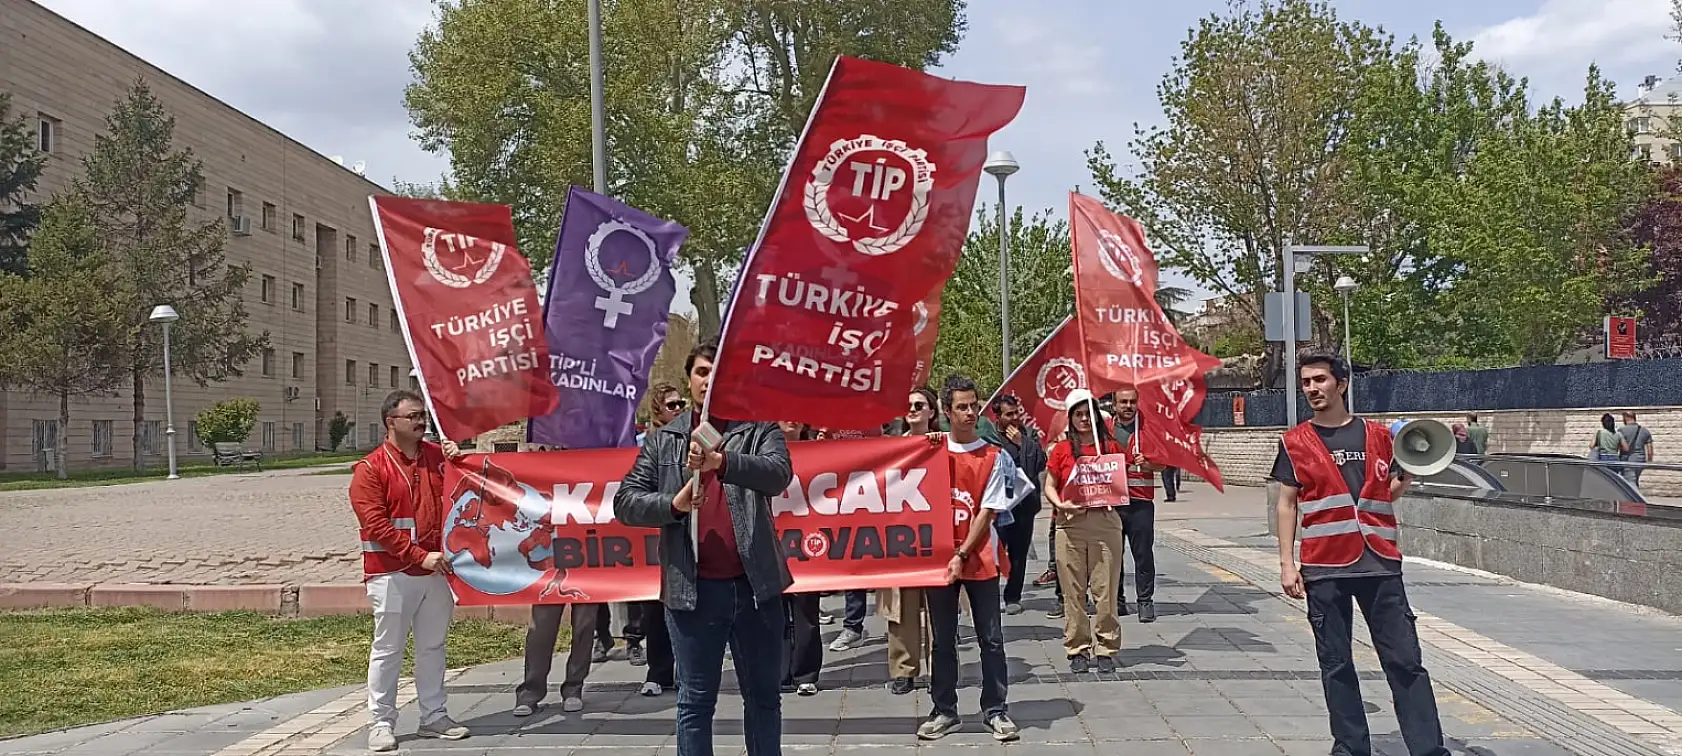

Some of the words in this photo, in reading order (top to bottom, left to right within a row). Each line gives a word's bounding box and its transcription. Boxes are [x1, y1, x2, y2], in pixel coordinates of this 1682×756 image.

[850, 157, 907, 201] TİP
[755, 272, 899, 318] TÜRKİYE
[431, 298, 528, 339] TÜRKİYE
[488, 318, 533, 348] İŞÇİ
[826, 321, 892, 360] İŞÇİ
[1106, 352, 1181, 369] PARTİSİ
[456, 347, 539, 387] PARTİSİ
[548, 352, 597, 376] TİP'Lİ
[752, 344, 883, 392] PARTİSİ
[552, 528, 634, 568] BİR
[819, 523, 933, 561] VAR!
